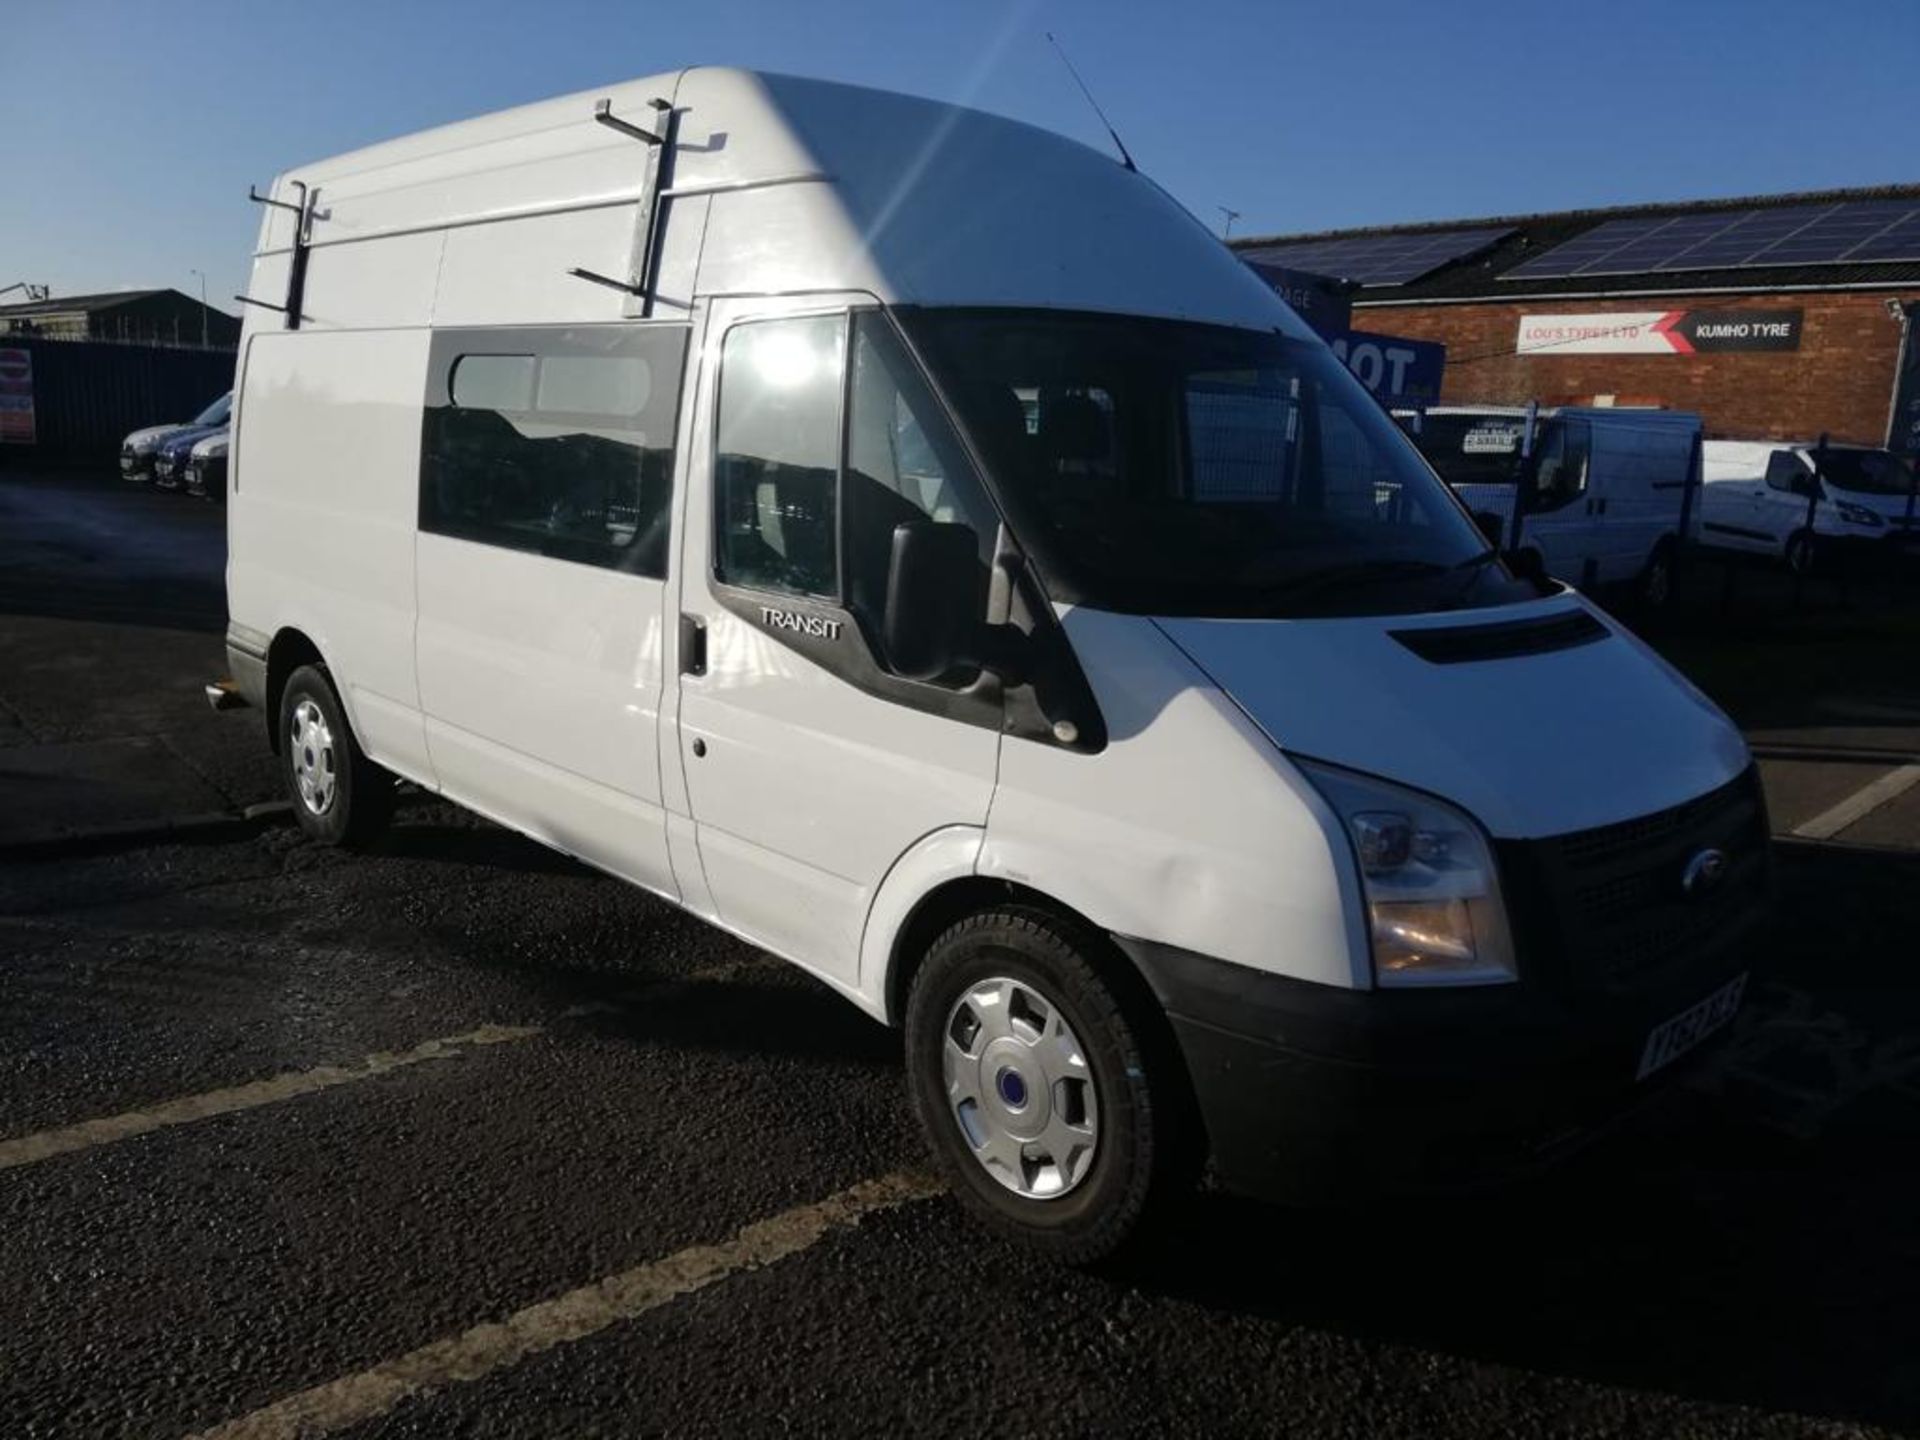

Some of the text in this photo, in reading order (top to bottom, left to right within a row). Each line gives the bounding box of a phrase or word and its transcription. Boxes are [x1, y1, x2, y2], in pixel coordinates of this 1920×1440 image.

[1696, 323, 1791, 338] KUMHO TYRE
[760, 606, 841, 640] TRANSIT
